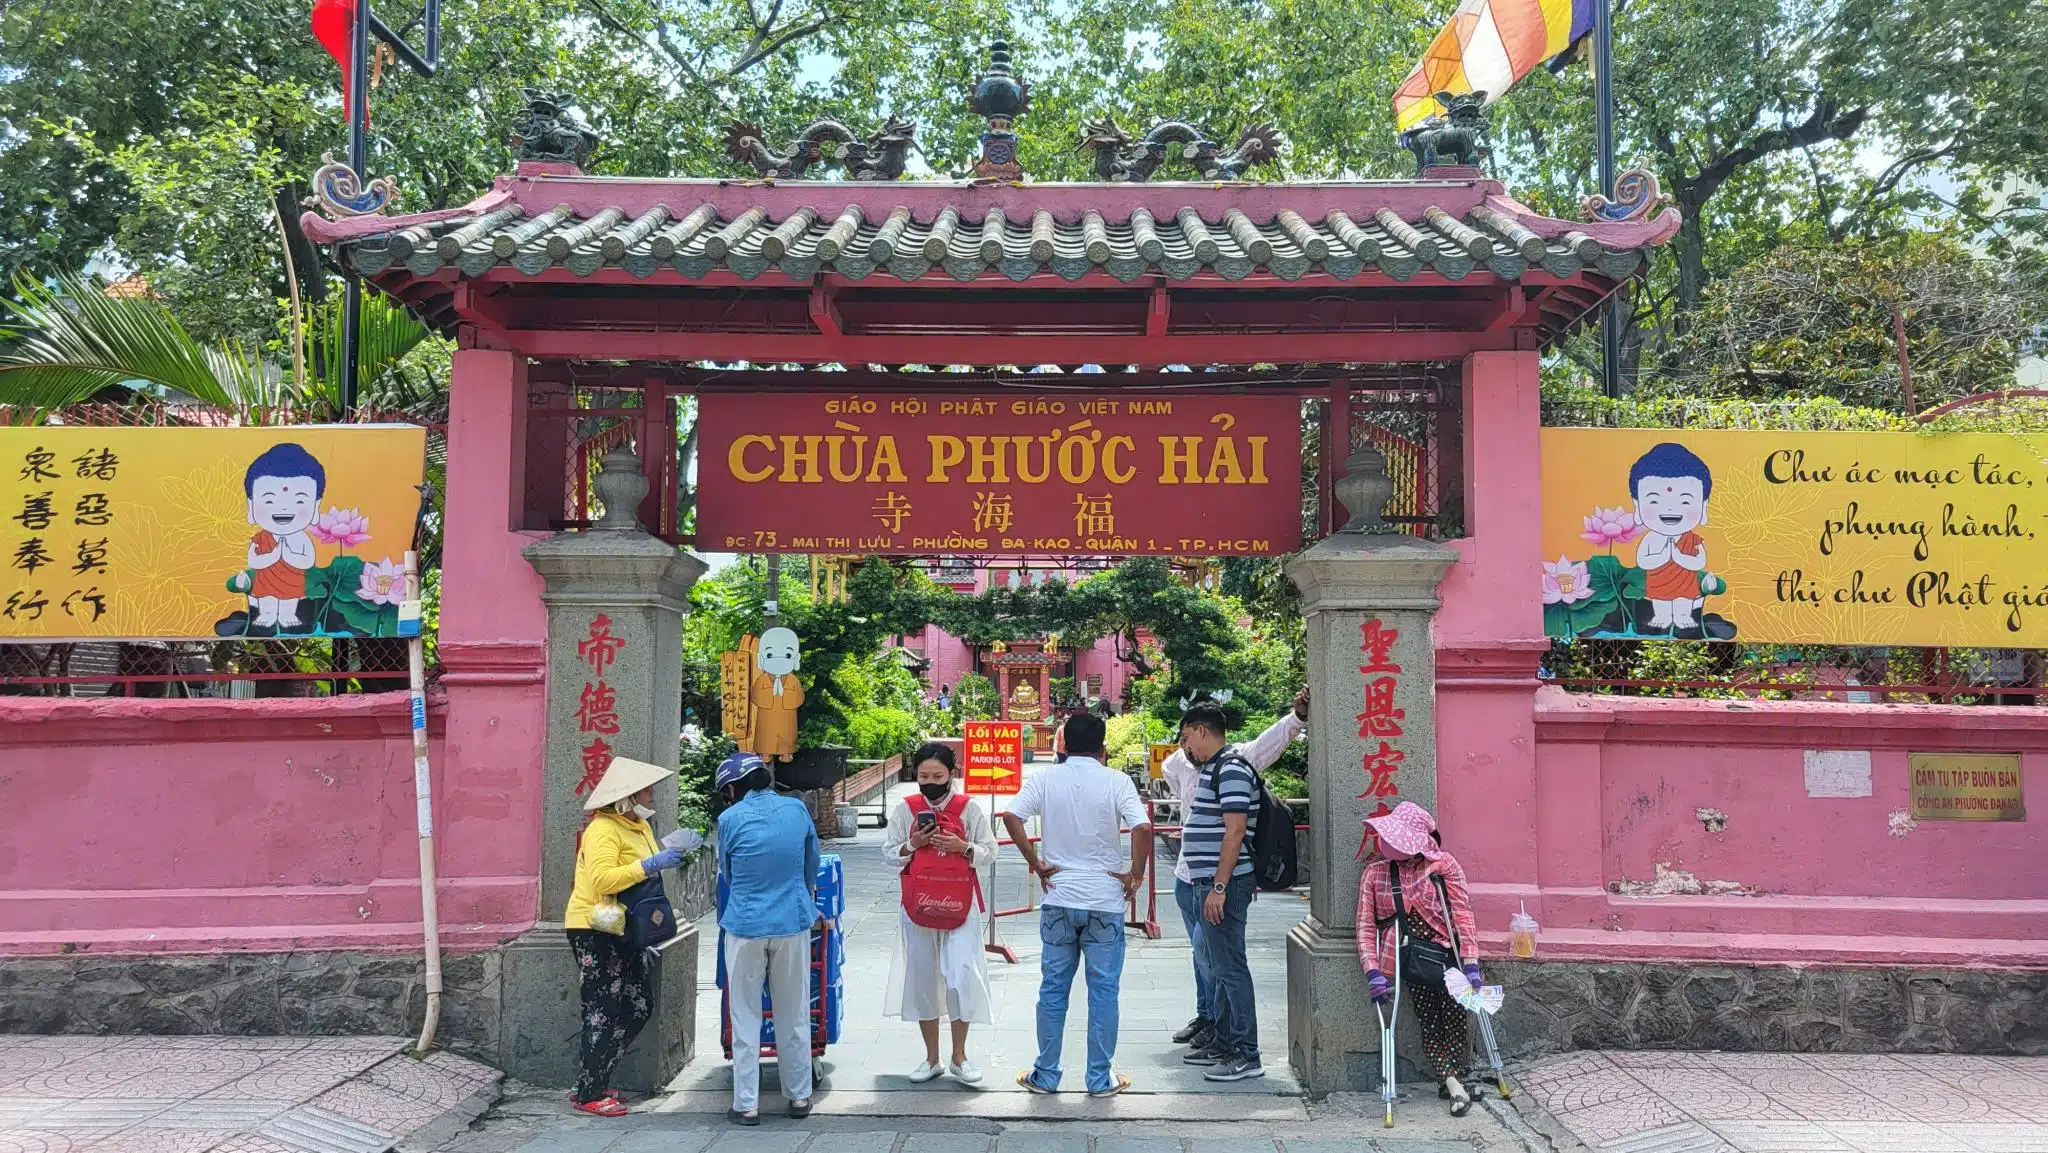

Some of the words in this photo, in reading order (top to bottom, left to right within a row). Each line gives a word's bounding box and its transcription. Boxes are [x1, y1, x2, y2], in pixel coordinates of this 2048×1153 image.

[824, 396, 877, 414] GIÁO
[891, 398, 927, 417] HỘI
[940, 397, 997, 417] PHẬT
[1011, 396, 1066, 415] GIÁO
[1079, 398, 1120, 417] VIỆT
[1128, 401, 1172, 415] NAM
[728, 420, 909, 484] CHÙA
[926, 419, 1137, 485] PHƯỚC
[1158, 413, 1269, 485] HẢI
[1763, 449, 1838, 485] Chư
[1845, 460, 1888, 485] ác
[1894, 466, 1967, 489] mạc
[1968, 453, 2034, 489] tác,
[792, 537, 820, 548] MAI
[826, 537, 851, 552] THỊ
[912, 530, 989, 549] PHƯỜNG
[1086, 536, 1138, 551] QUẬN
[1147, 540, 1157, 550] 1
[1179, 539, 1270, 551] TP.HCM
[1819, 501, 1934, 562] phụng
[1941, 503, 2035, 541] hành,
[1771, 569, 1827, 608] thị
[1833, 569, 1897, 604] chư
[1906, 571, 1997, 611] Phật
[993, 727, 1019, 738] VÀO
[971, 741, 994, 753] BÃI
[997, 743, 1015, 753] XE
[970, 755, 1001, 764] PARKING
[1002, 756, 1017, 764] LOT
[1915, 760, 1936, 787] CẤM
[1971, 766, 1997, 788] BUÔN
[1999, 766, 2017, 788] BÁN
[1942, 797, 1953, 809] AN
[917, 892, 964, 912] Yankees
